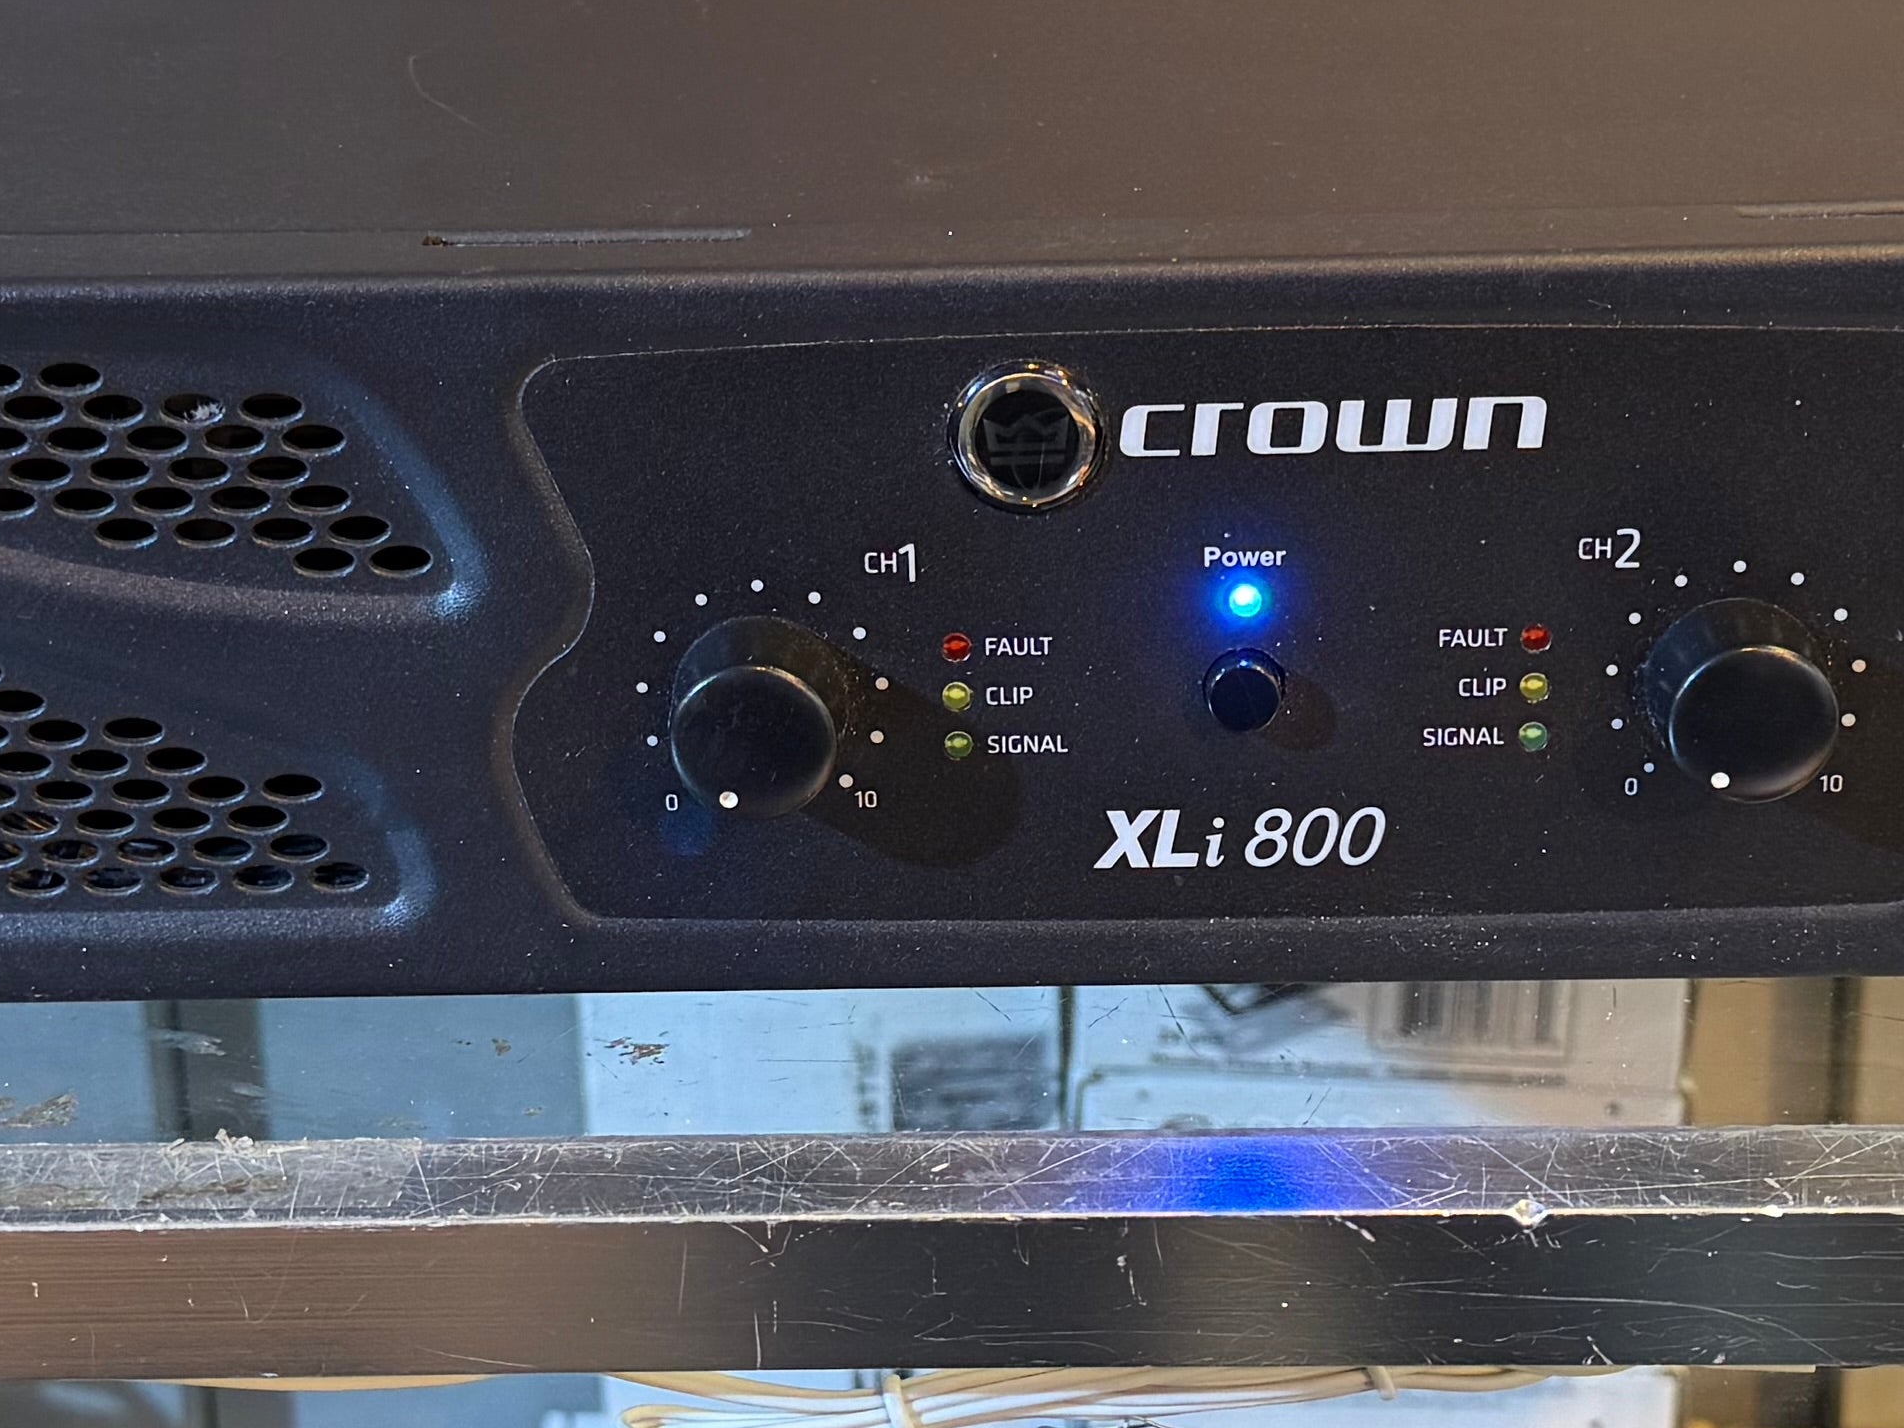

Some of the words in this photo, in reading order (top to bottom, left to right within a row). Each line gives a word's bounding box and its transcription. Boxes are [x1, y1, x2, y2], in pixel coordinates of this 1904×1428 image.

[1119, 395, 1549, 460] crown
[1203, 545, 1287, 568] Power
[984, 635, 1053, 658] FAULT
[1438, 626, 1509, 649] FAULT
[985, 685, 1034, 708] CLIP
[1458, 676, 1508, 698] CLIP
[986, 733, 1069, 755] SIGNAL
[1422, 725, 1505, 748] SIGNAL
[1623, 776, 1639, 797] 0
[1818, 774, 1845, 794] 10
[665, 793, 679, 812] 0
[853, 790, 877, 809] 10
[1093, 808, 1227, 871] XLi
[1243, 805, 1387, 869] 800
